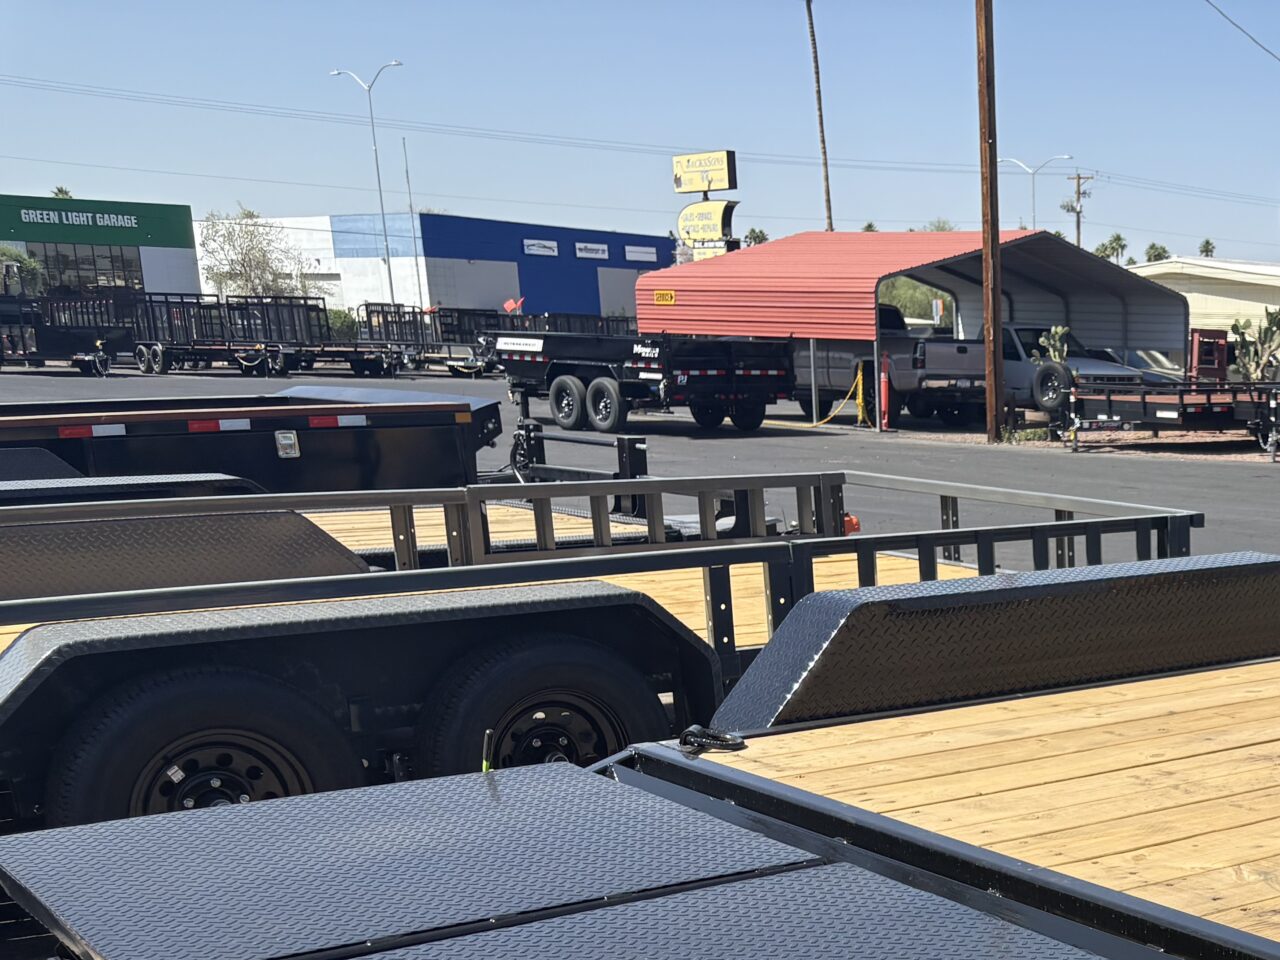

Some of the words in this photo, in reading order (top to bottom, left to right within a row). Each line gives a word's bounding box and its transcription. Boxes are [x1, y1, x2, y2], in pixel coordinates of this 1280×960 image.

[20, 208, 60, 224] GREEN
[61, 210, 94, 226] LIGHT
[95, 212, 138, 228] GARAGE
